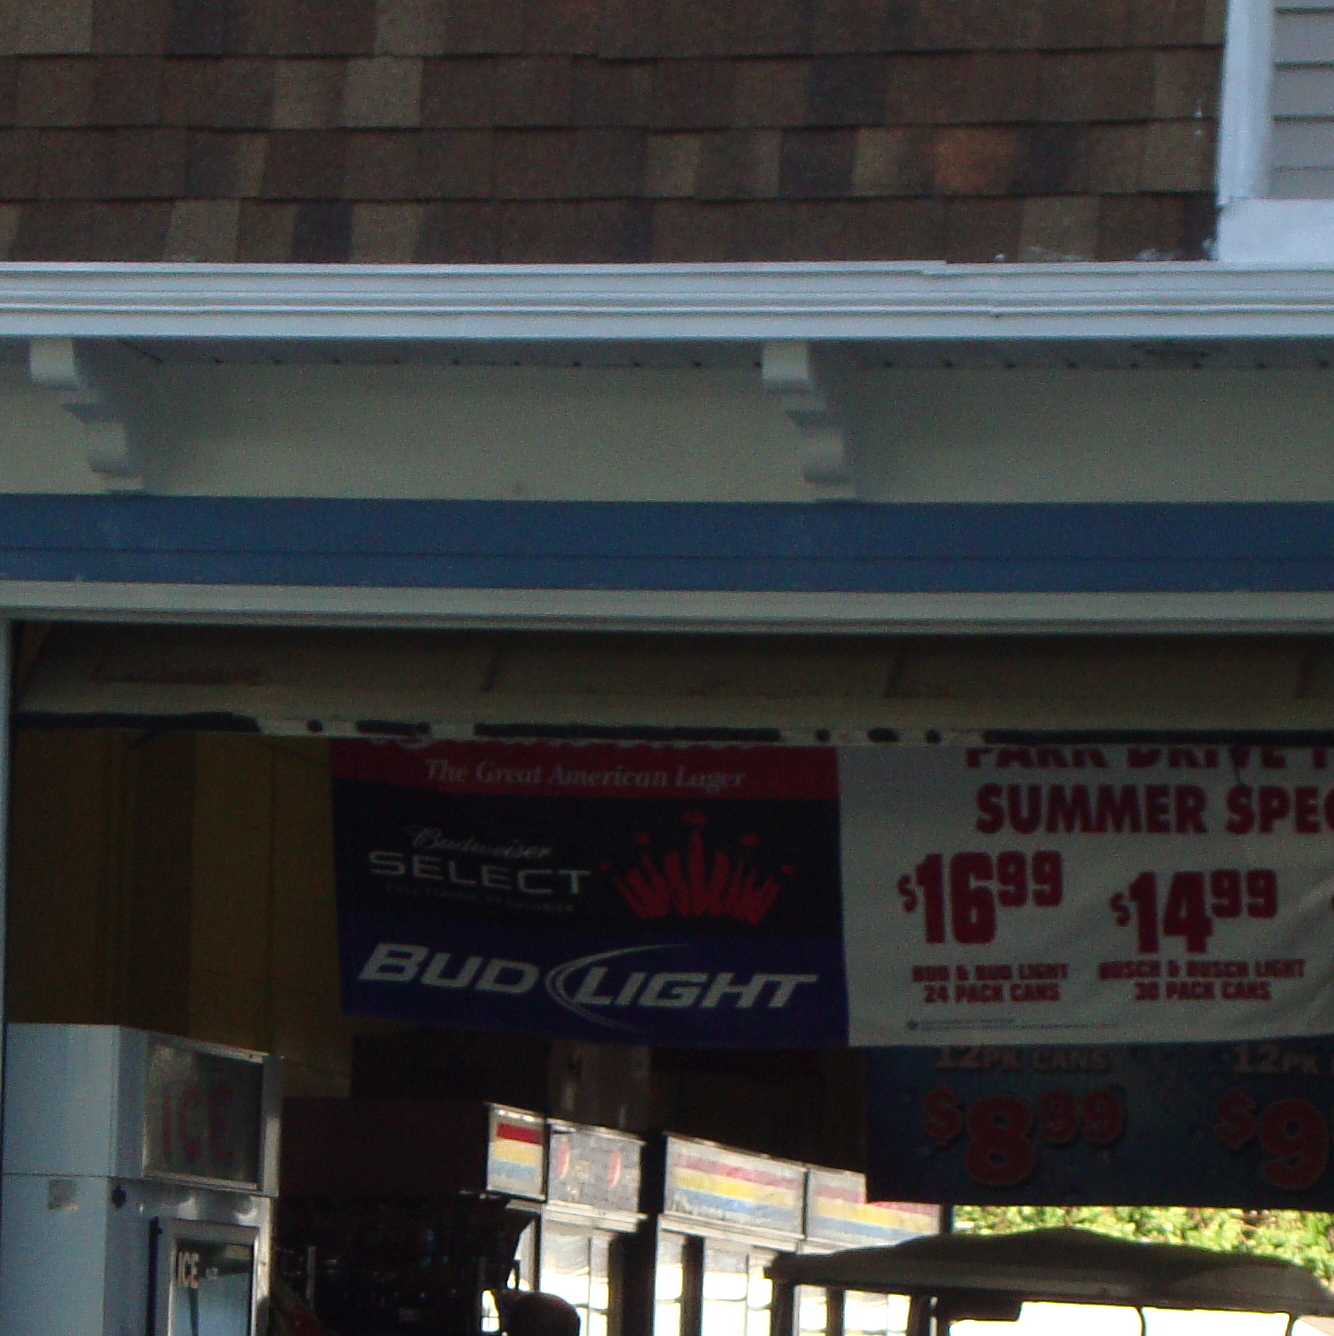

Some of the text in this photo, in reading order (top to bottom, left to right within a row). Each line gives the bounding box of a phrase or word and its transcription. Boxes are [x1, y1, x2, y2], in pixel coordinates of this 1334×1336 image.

[425, 758, 747, 793] The Great American Lager
[976, 783, 1207, 834] SUMMER
[405, 824, 552, 859] Budweiser
[368, 850, 592, 895] SELECT
[358, 942, 819, 1009] BUD LIGHT
[955, 984, 1004, 1003] PACK
[1010, 983, 1060, 1002] CANS
[1166, 981, 1216, 1000] PACK
[163, 1084, 234, 1162] ICE
